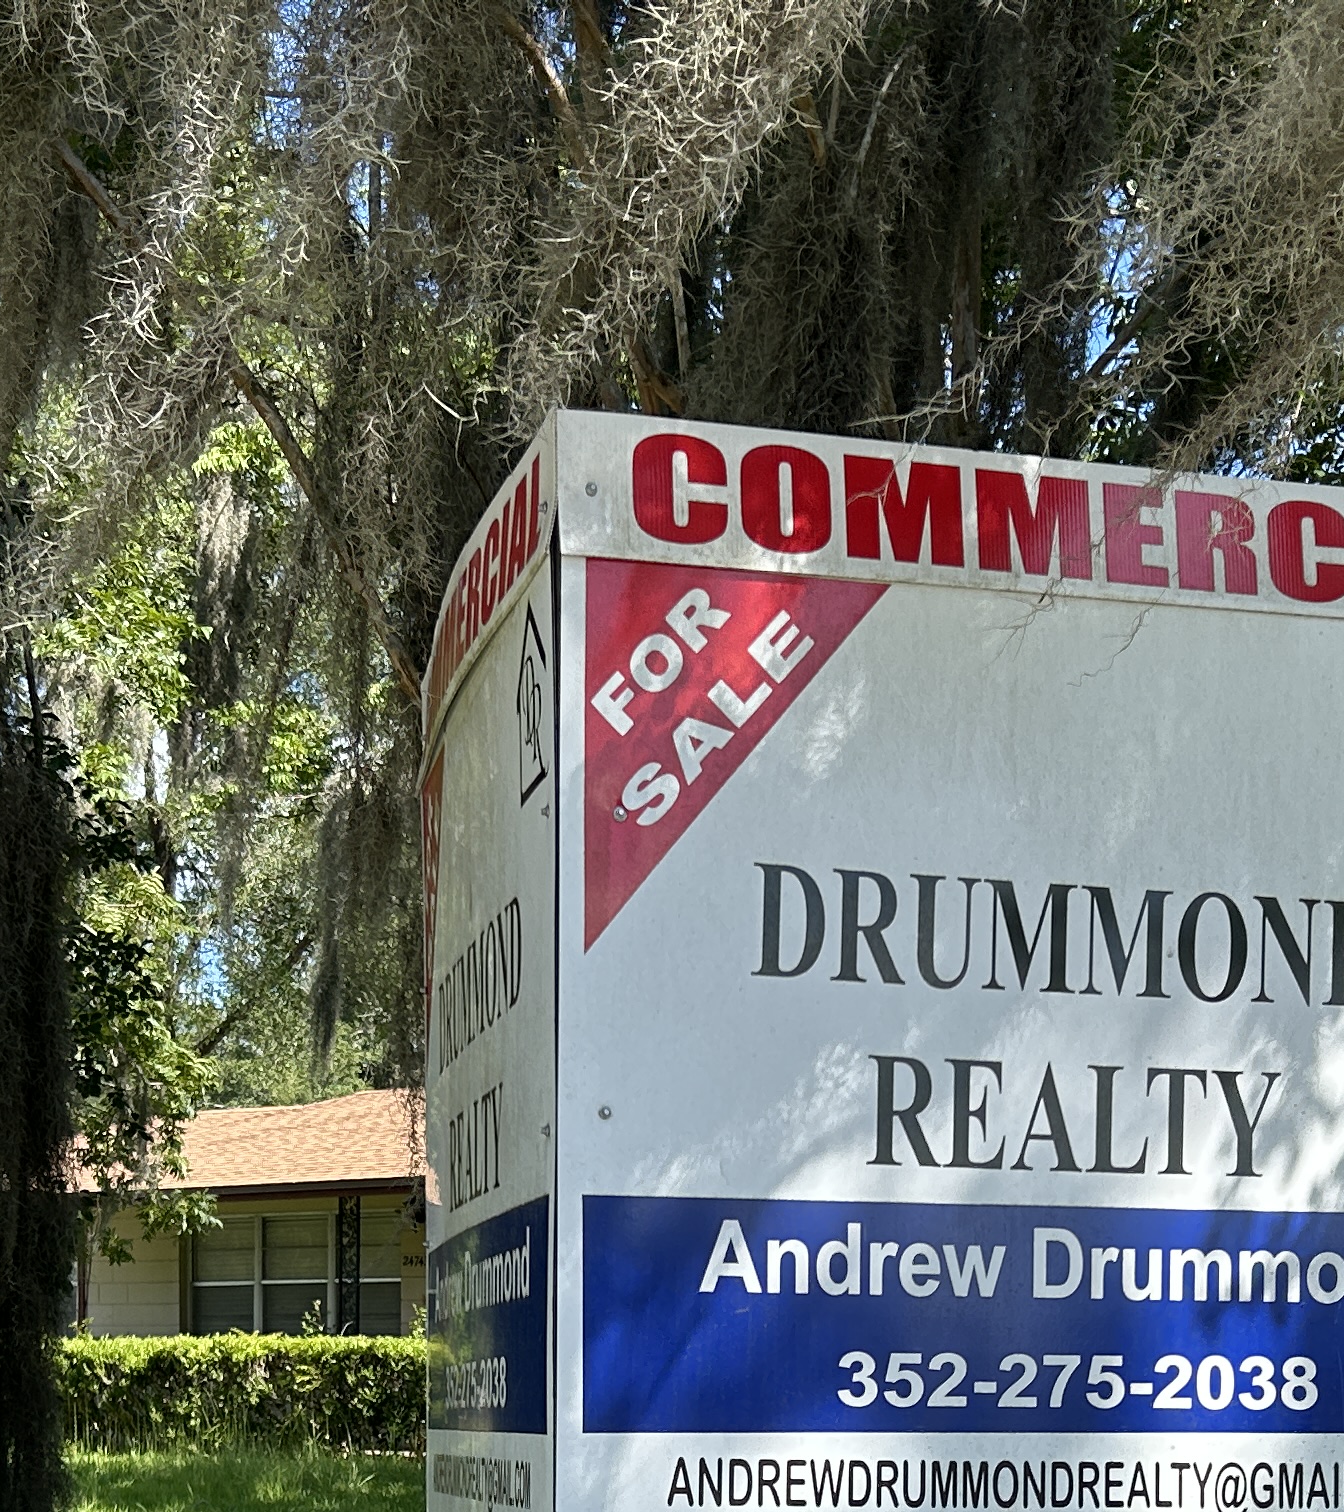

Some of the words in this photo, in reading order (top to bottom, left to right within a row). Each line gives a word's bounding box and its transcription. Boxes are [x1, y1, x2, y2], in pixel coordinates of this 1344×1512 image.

[591, 588, 732, 737] FOR
[621, 610, 815, 826] SALE
[440, 897, 522, 1076] DRUMMOND
[449, 1082, 503, 1213] REALTY
[867, 1054, 1281, 1177] REALTY
[464, 1226, 530, 1312] Drummond
[699, 1219, 1007, 1297] Andrew
[836, 1350, 1319, 1412] 352-275-2038
